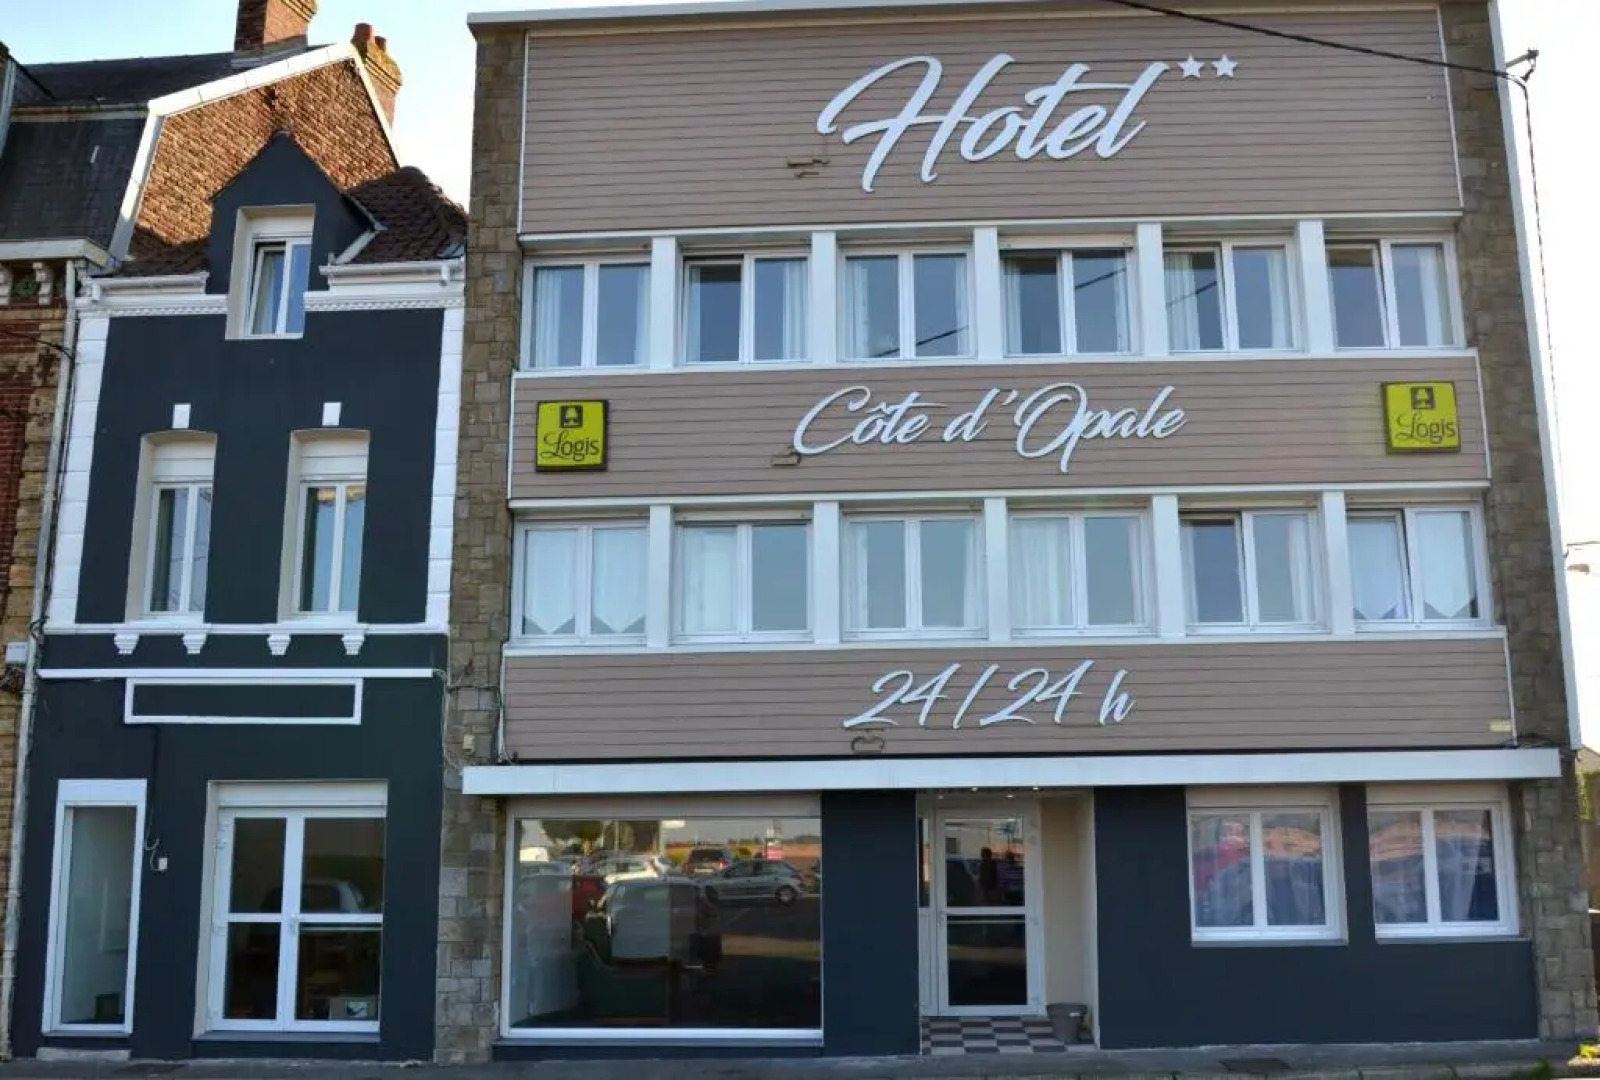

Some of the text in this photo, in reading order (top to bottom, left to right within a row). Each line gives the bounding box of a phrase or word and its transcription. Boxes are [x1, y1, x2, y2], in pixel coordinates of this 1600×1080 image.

[816, 53, 1171, 193] Hotel
[540, 430, 600, 462] Logis
[793, 385, 948, 455] Côte
[1395, 411, 1456, 445] Logis
[1099, 669, 1137, 726] h
